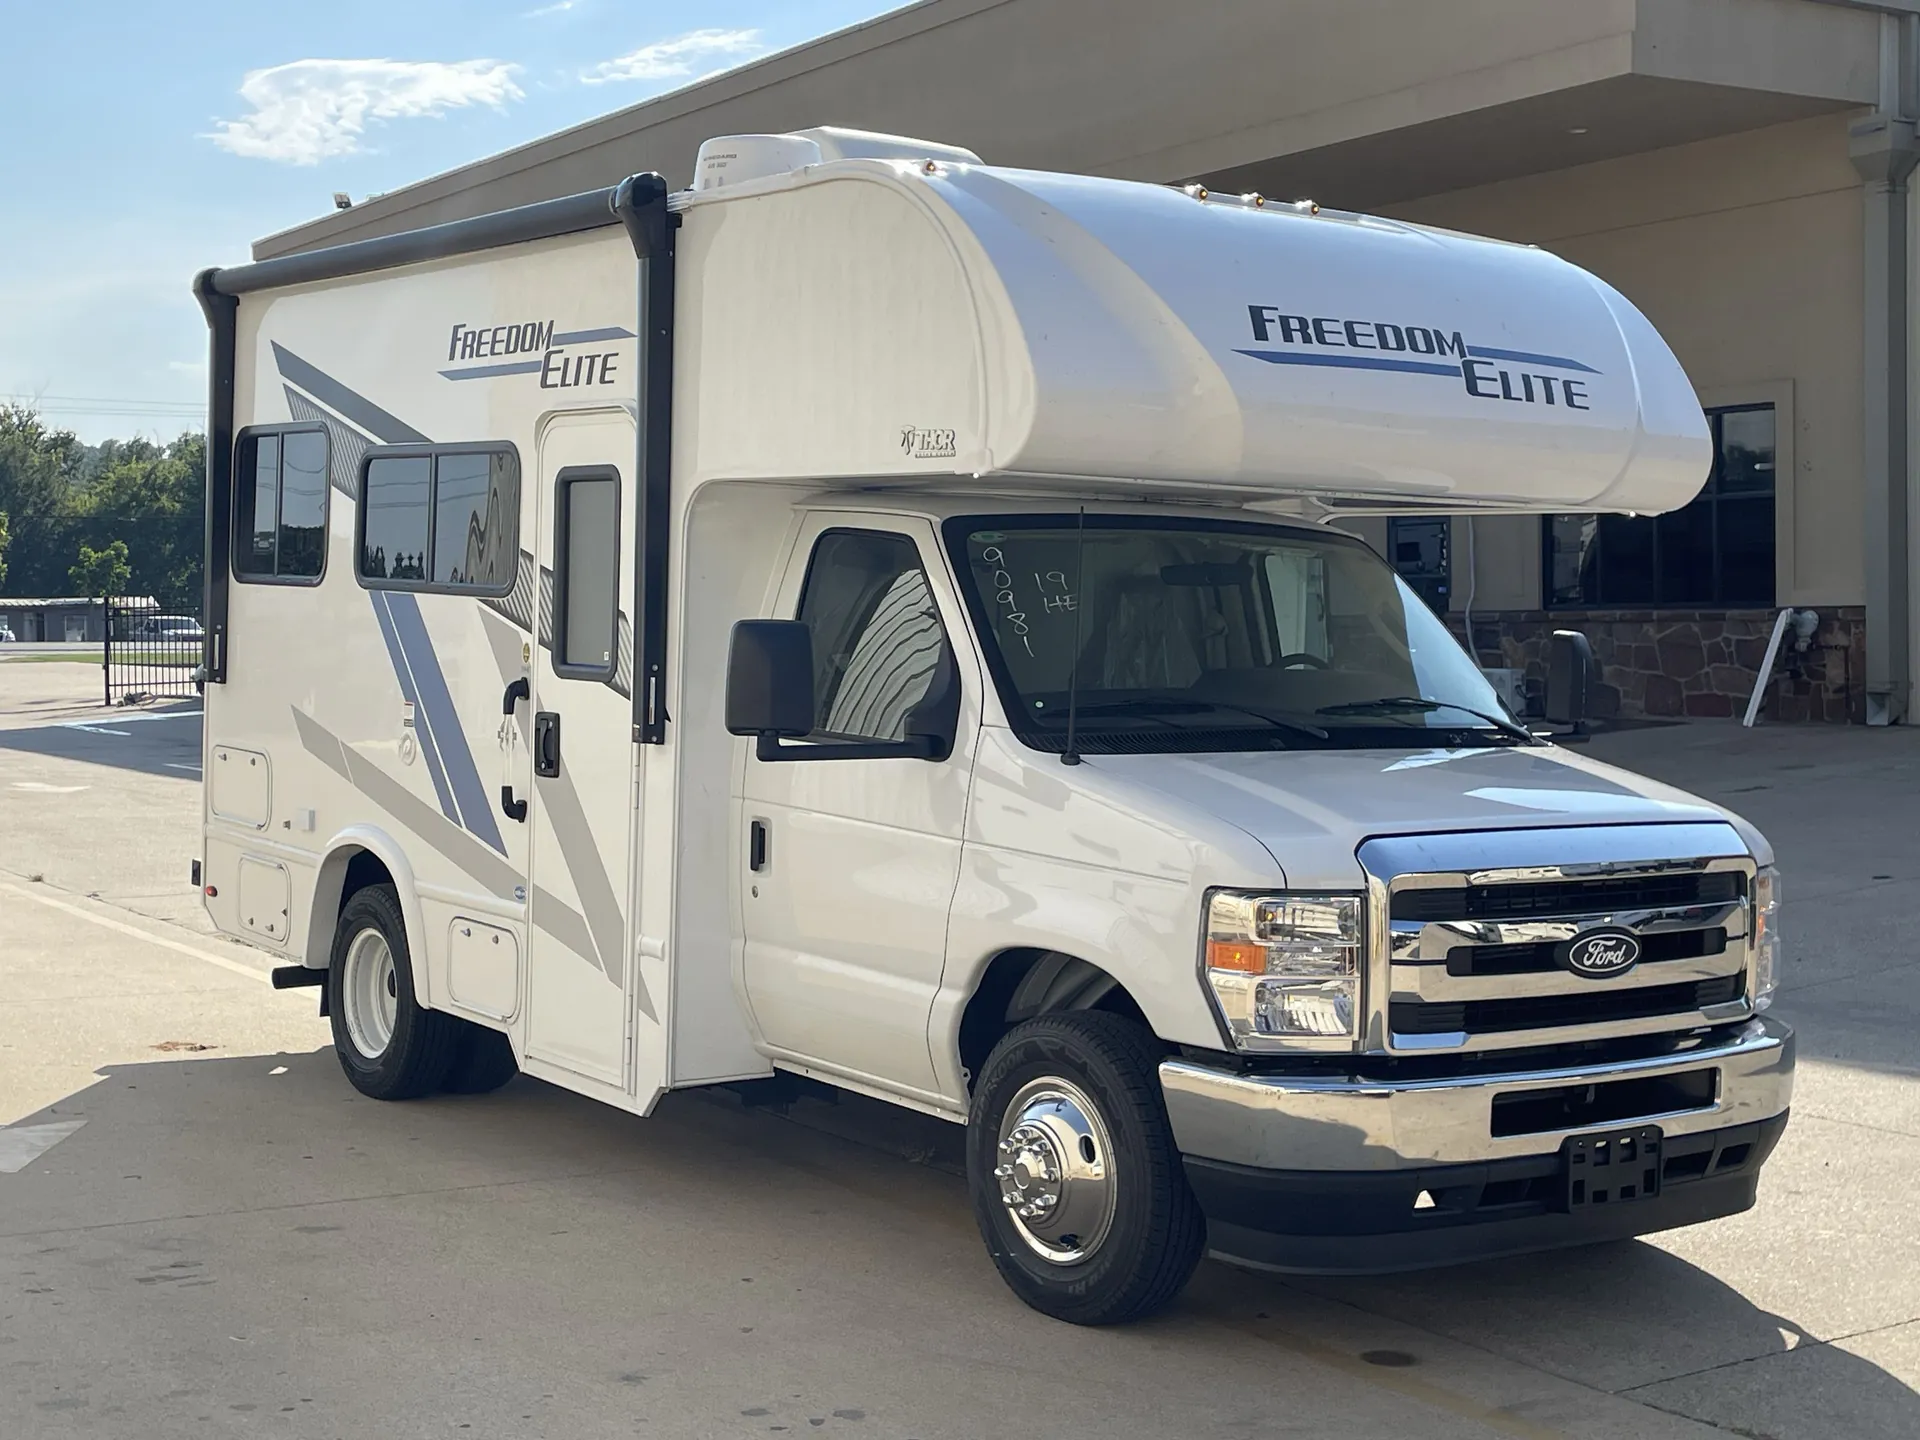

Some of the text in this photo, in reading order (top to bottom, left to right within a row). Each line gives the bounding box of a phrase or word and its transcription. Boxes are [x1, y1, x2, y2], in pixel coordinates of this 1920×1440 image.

[448, 319, 555, 362] FREEDOM
[1247, 304, 1468, 359] FREEDOM
[539, 348, 620, 389] ELITE
[1461, 358, 1590, 411] ELITE
[1034, 570, 1069, 593] 19
[1583, 939, 1627, 967] Ford
